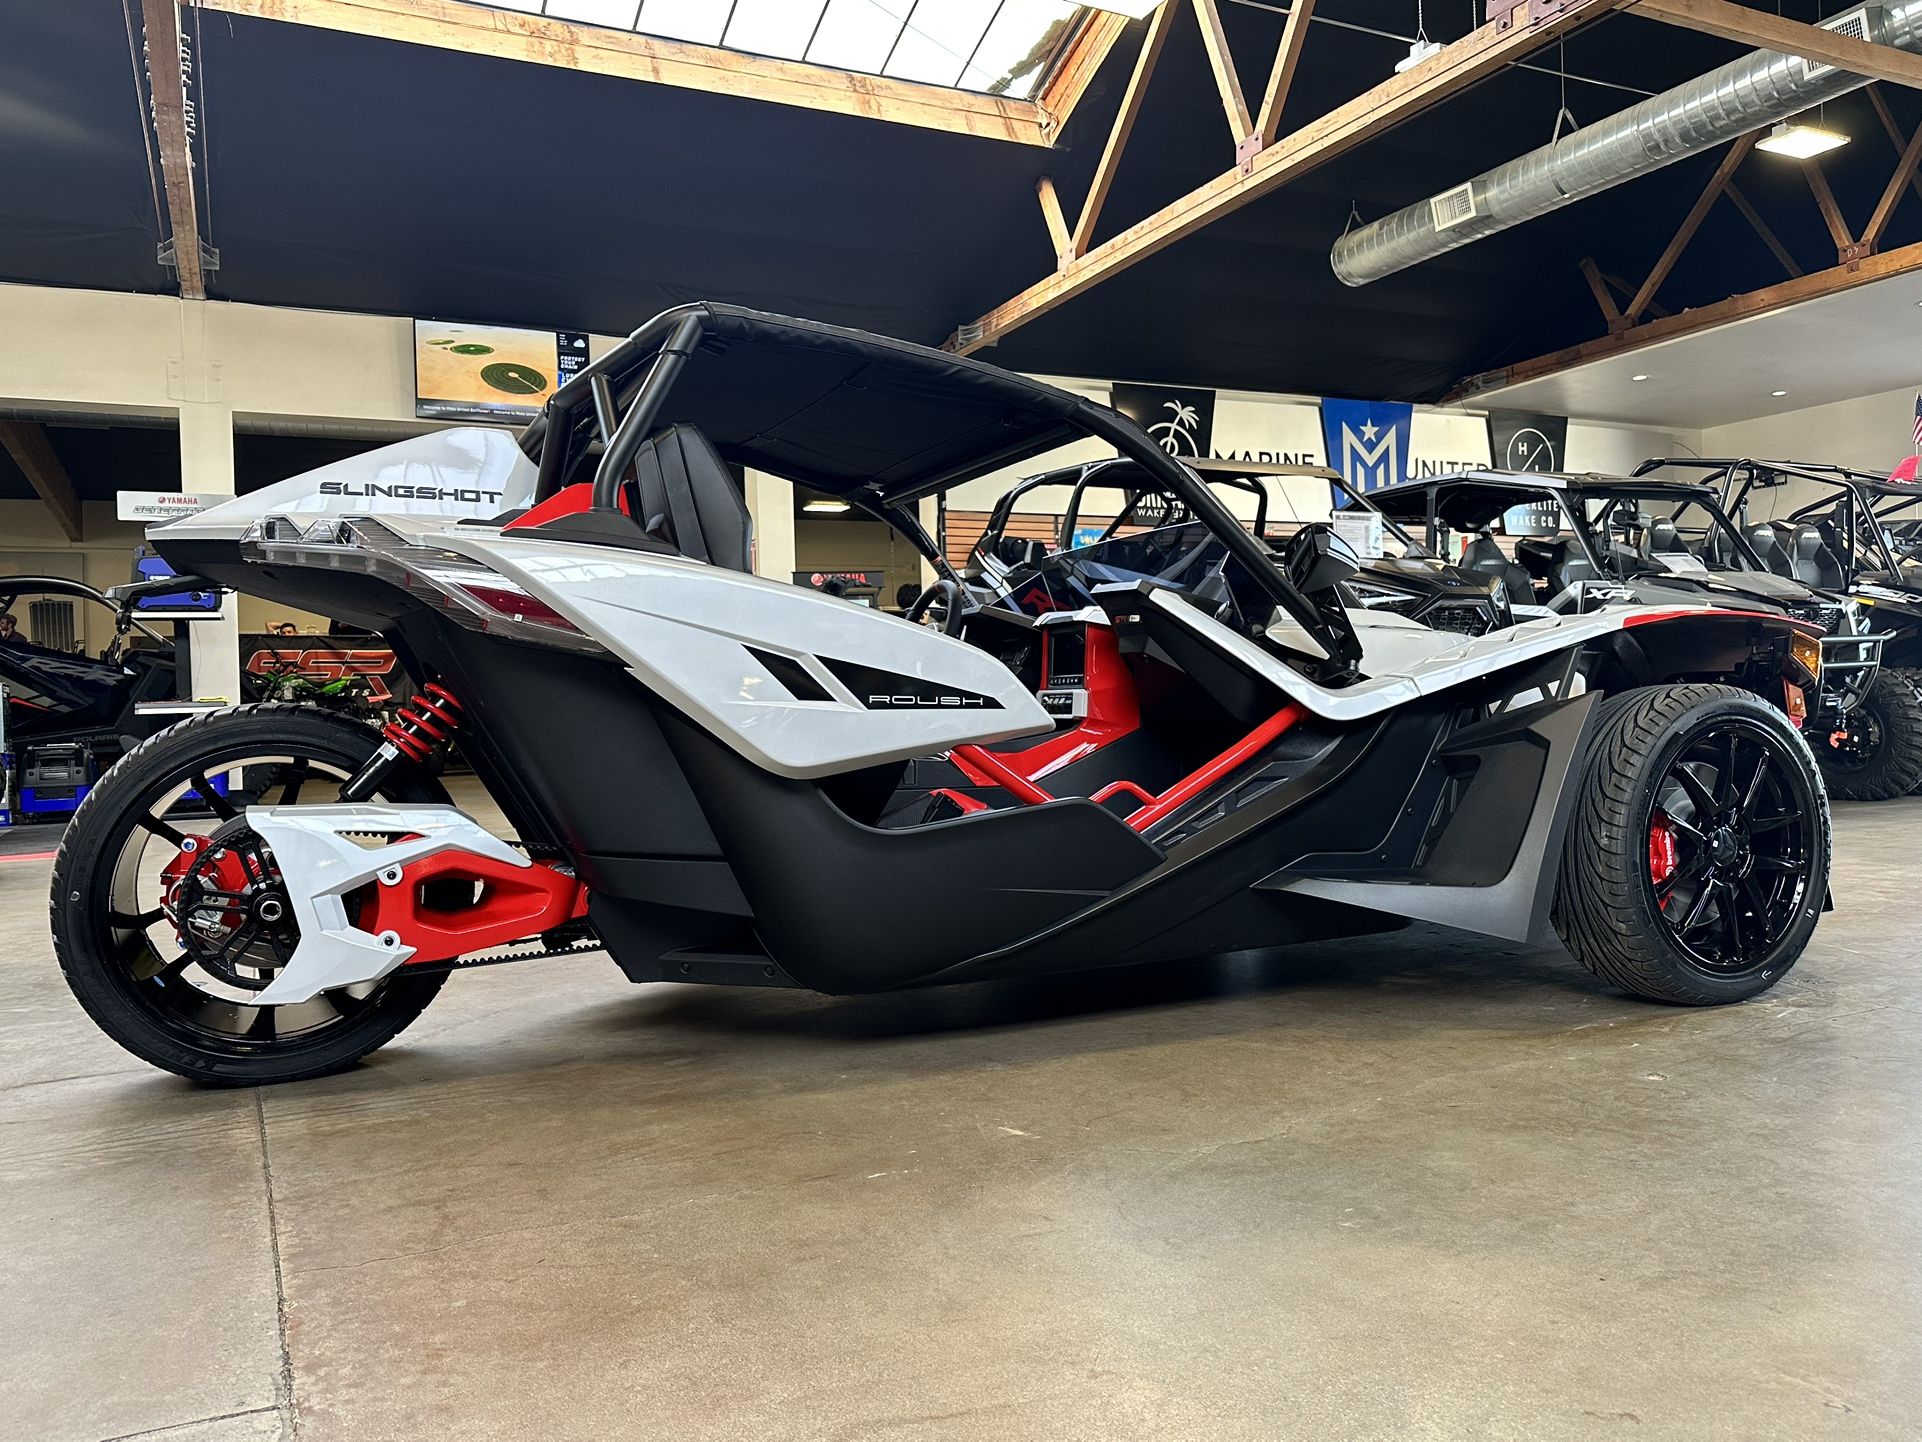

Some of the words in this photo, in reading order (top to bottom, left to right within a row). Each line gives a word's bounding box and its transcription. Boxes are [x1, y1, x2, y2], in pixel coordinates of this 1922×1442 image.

[319, 481, 503, 504] SLINGSHOT
[167, 496, 198, 505] YAMAHA
[1511, 515, 1536, 527] WAKE
[1541, 515, 1556, 527] CO.
[869, 695, 984, 706] ROUSH
